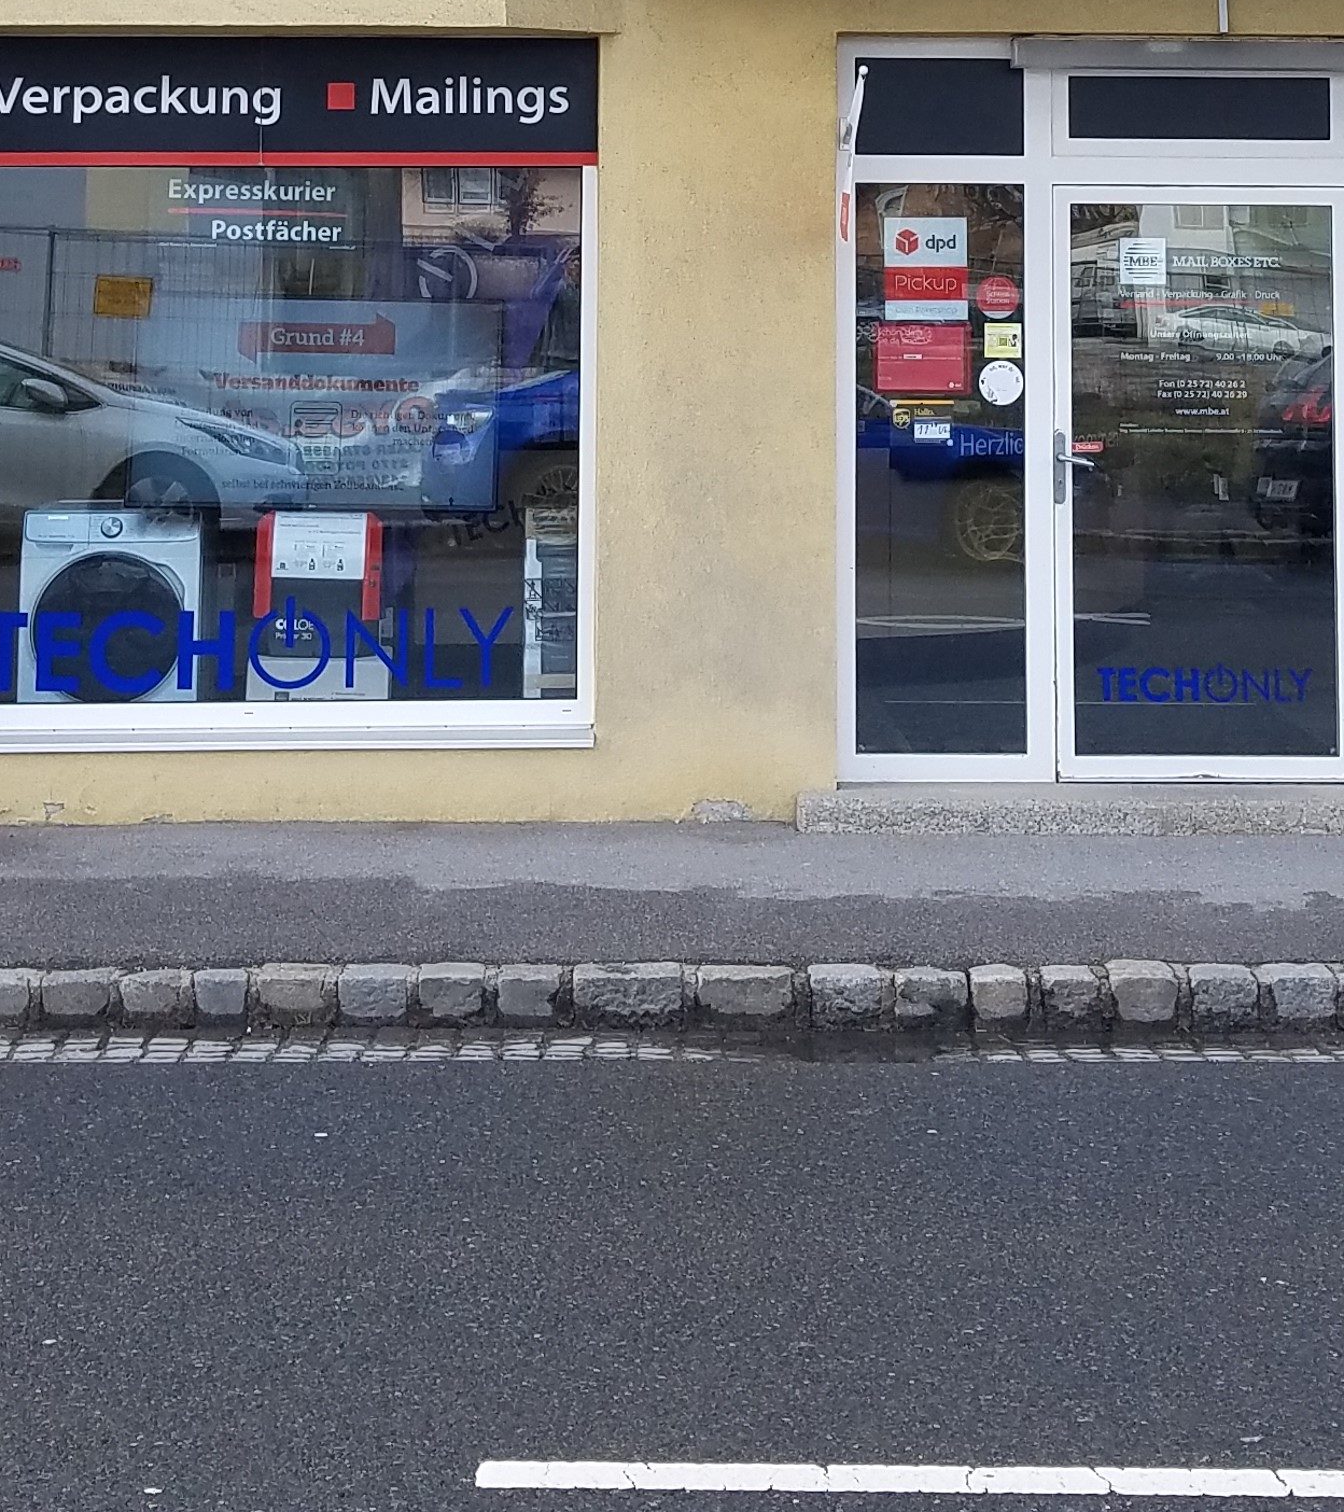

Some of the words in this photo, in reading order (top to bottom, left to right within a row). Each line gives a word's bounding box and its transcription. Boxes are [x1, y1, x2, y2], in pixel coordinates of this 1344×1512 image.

[370, 76, 570, 125] Mailings
[168, 179, 336, 204] Expresskurier
[211, 220, 342, 242] Postfächer
[925, 234, 957, 253] dpd
[1129, 256, 1158, 267] MBE
[1172, 256, 1208, 267] MAIL
[1210, 256, 1252, 267] BOXES
[895, 275, 957, 294] Pickup
[1220, 290, 1247, 299] Grafik
[1255, 290, 1280, 299] Druck
[271, 328, 335, 346] Grund
[339, 328, 366, 346] #4
[1120, 352, 1154, 363] Montag
[1160, 352, 1191, 363] Freitag
[213, 373, 419, 393] Versanddokumente
[1158, 380, 1175, 388] Fon
[1157, 390, 1172, 398] Fax
[1175, 407, 1230, 416] www.mbe.at
[959, 433, 1024, 456] Herzlic
[1097, 663, 1313, 703] TECHONLY
